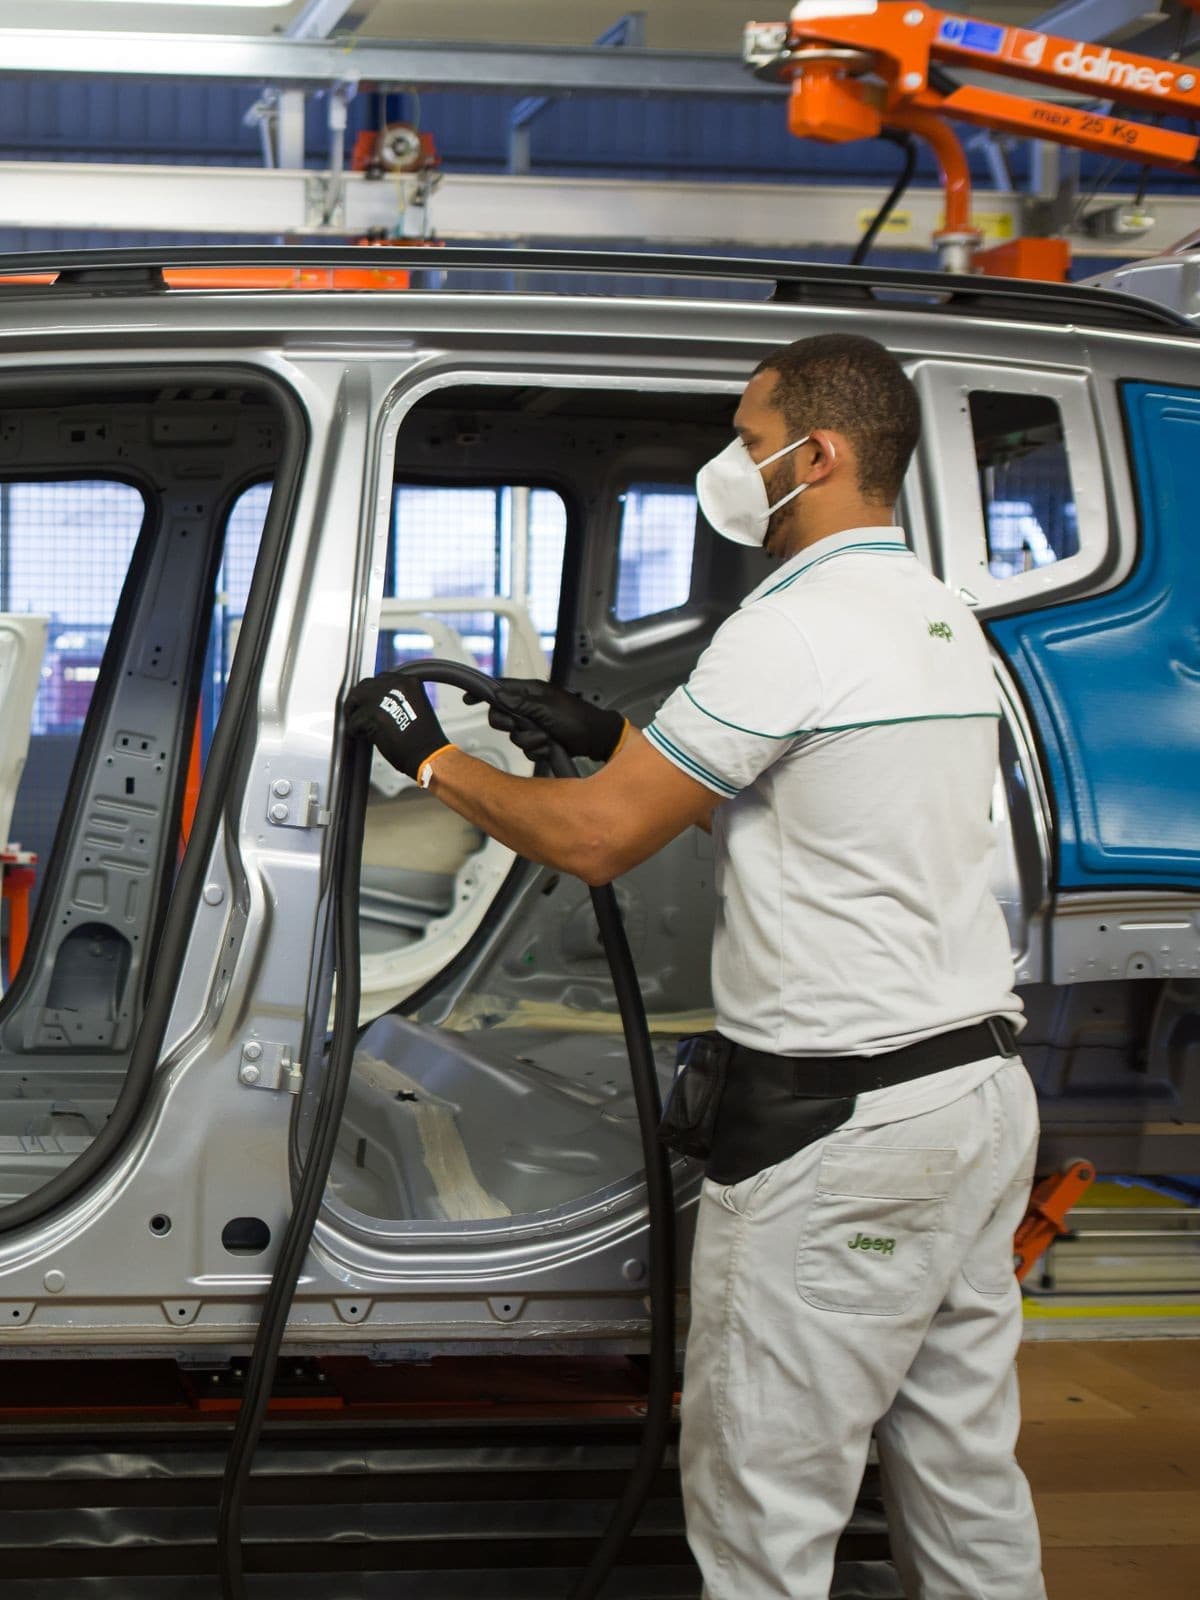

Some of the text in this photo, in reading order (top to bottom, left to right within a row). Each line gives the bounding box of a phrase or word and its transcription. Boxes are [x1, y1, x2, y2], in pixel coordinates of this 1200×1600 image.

[1054, 42, 1174, 95] dalmec
[1079, 114, 1104, 134] 25
[848, 1232, 896, 1255] Jeep
